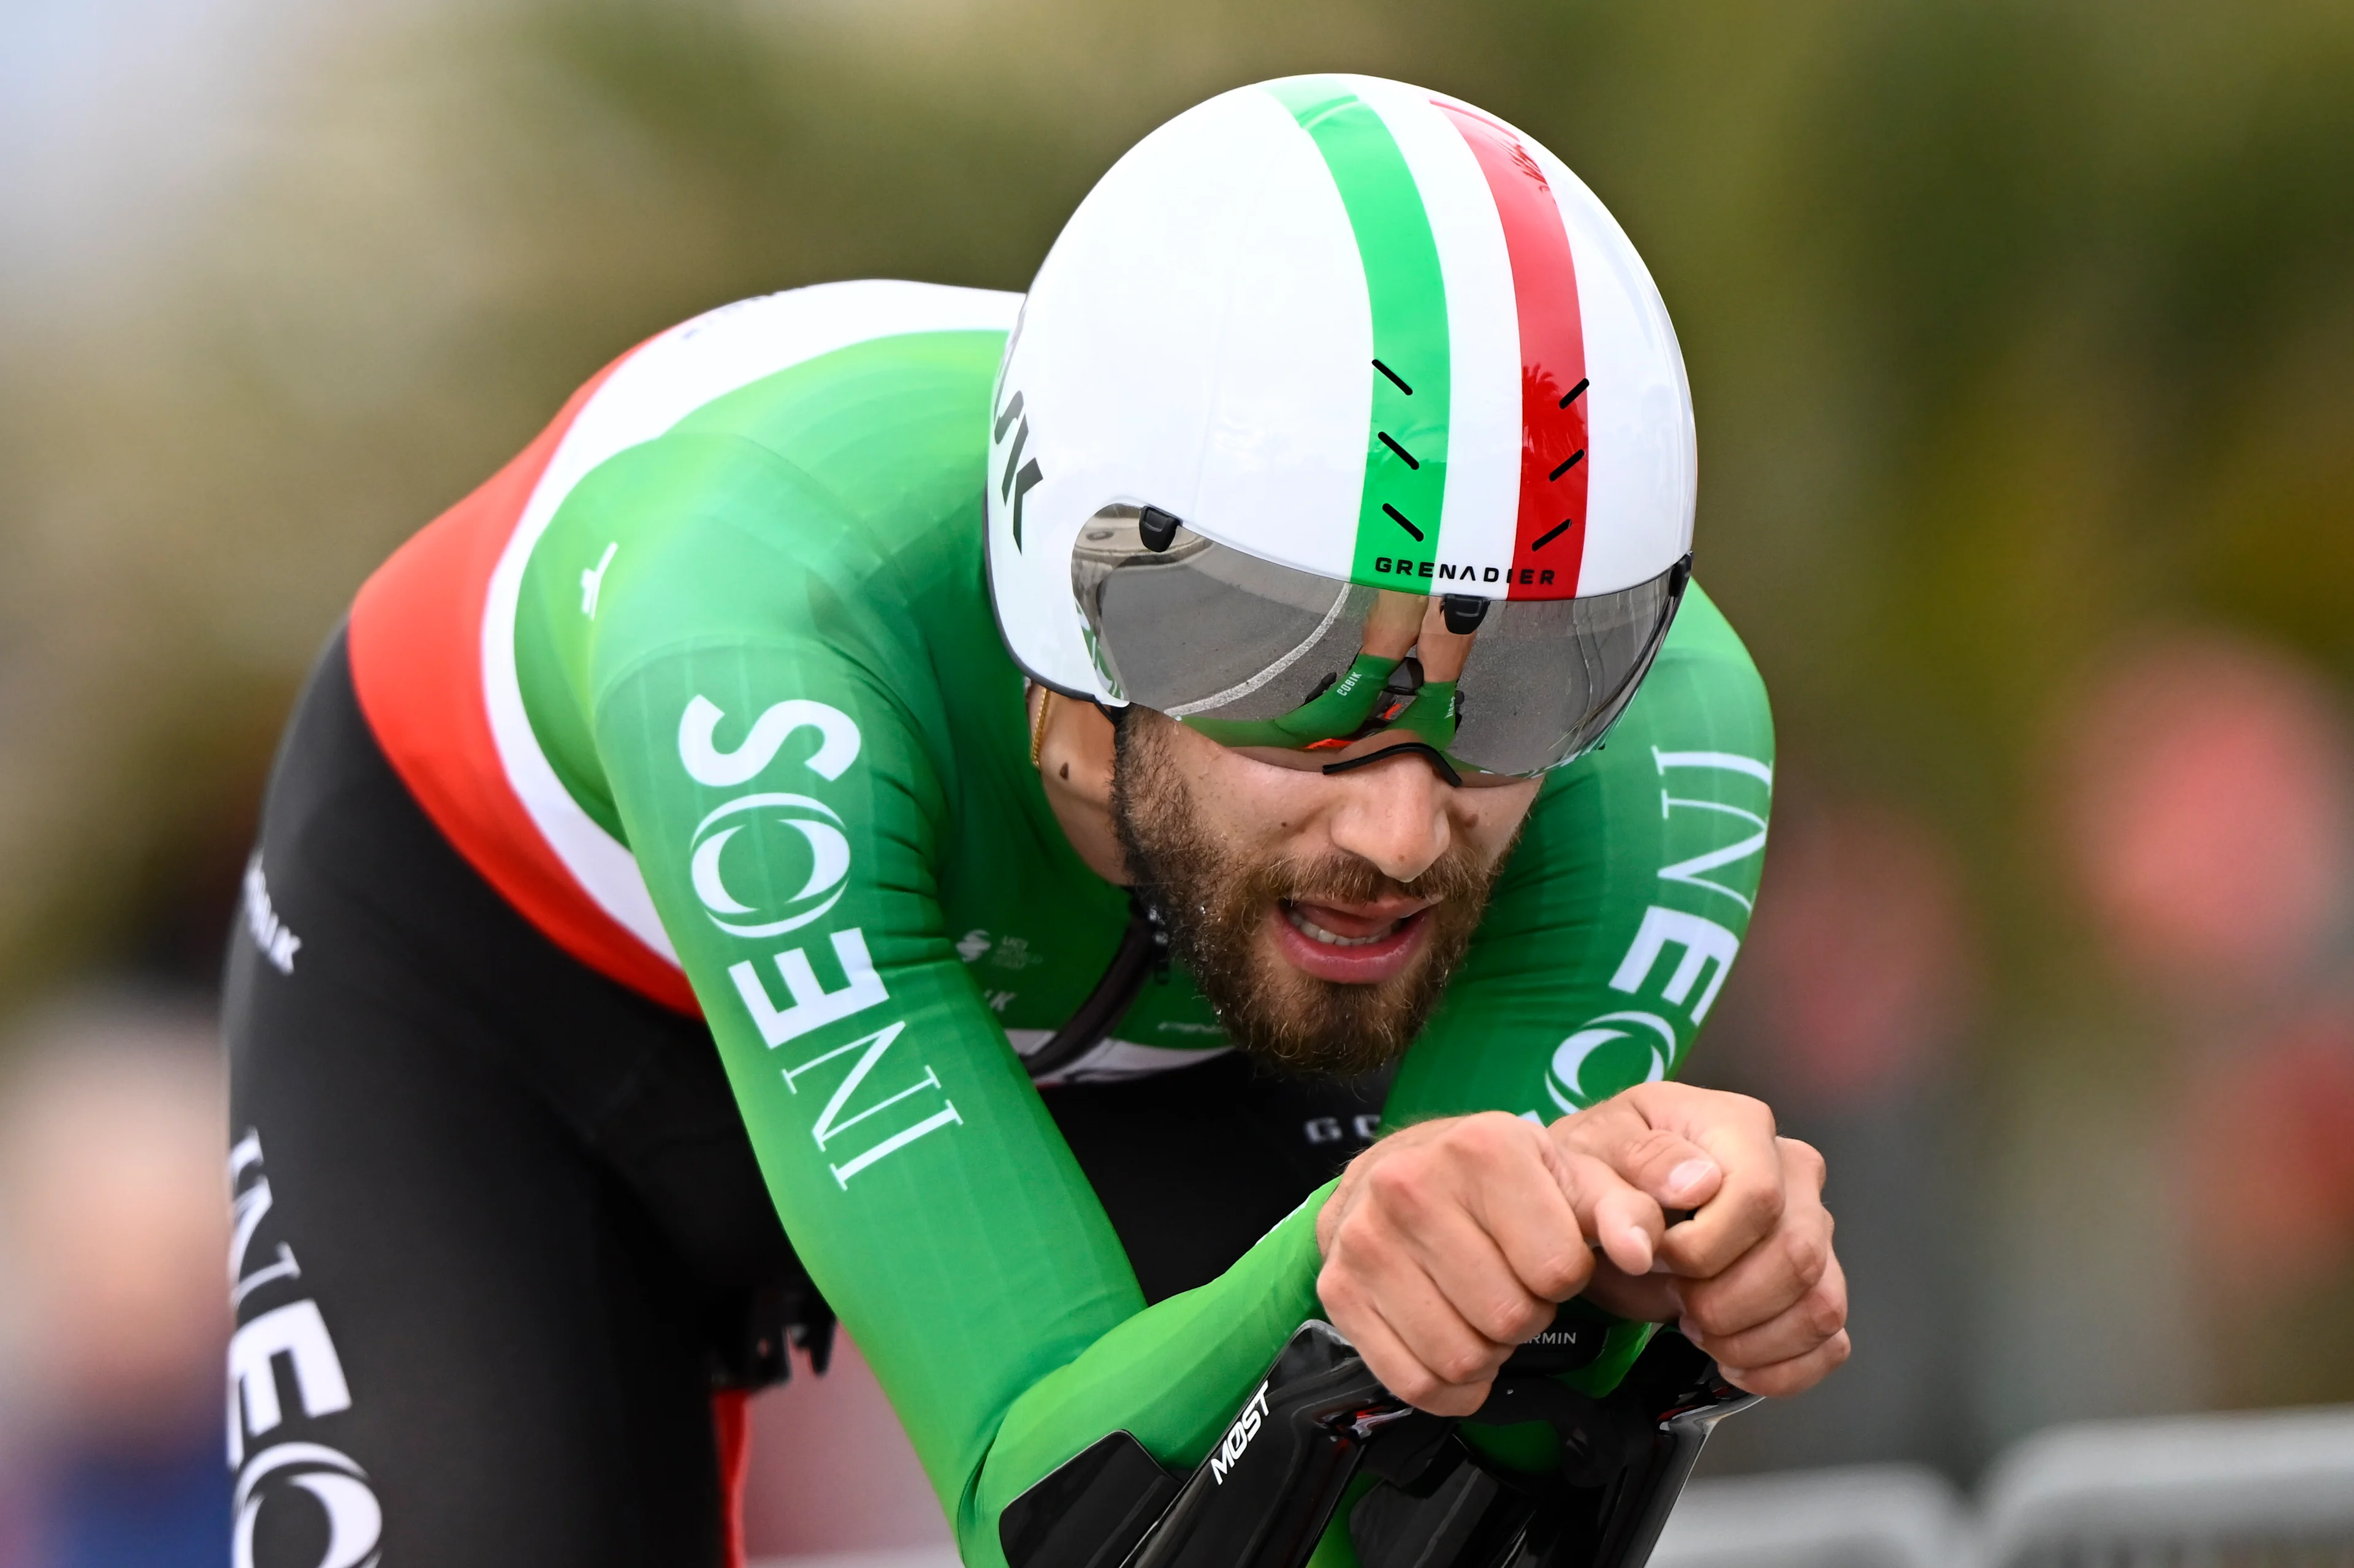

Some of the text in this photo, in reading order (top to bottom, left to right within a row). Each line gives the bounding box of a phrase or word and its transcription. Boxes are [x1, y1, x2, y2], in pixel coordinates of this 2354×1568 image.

[1375, 557, 1555, 585] GRENADIER
[678, 694, 963, 1190] INEOS
[1519, 745, 1773, 1127] INEO
[1520, 1331, 1576, 1344] RMIN
